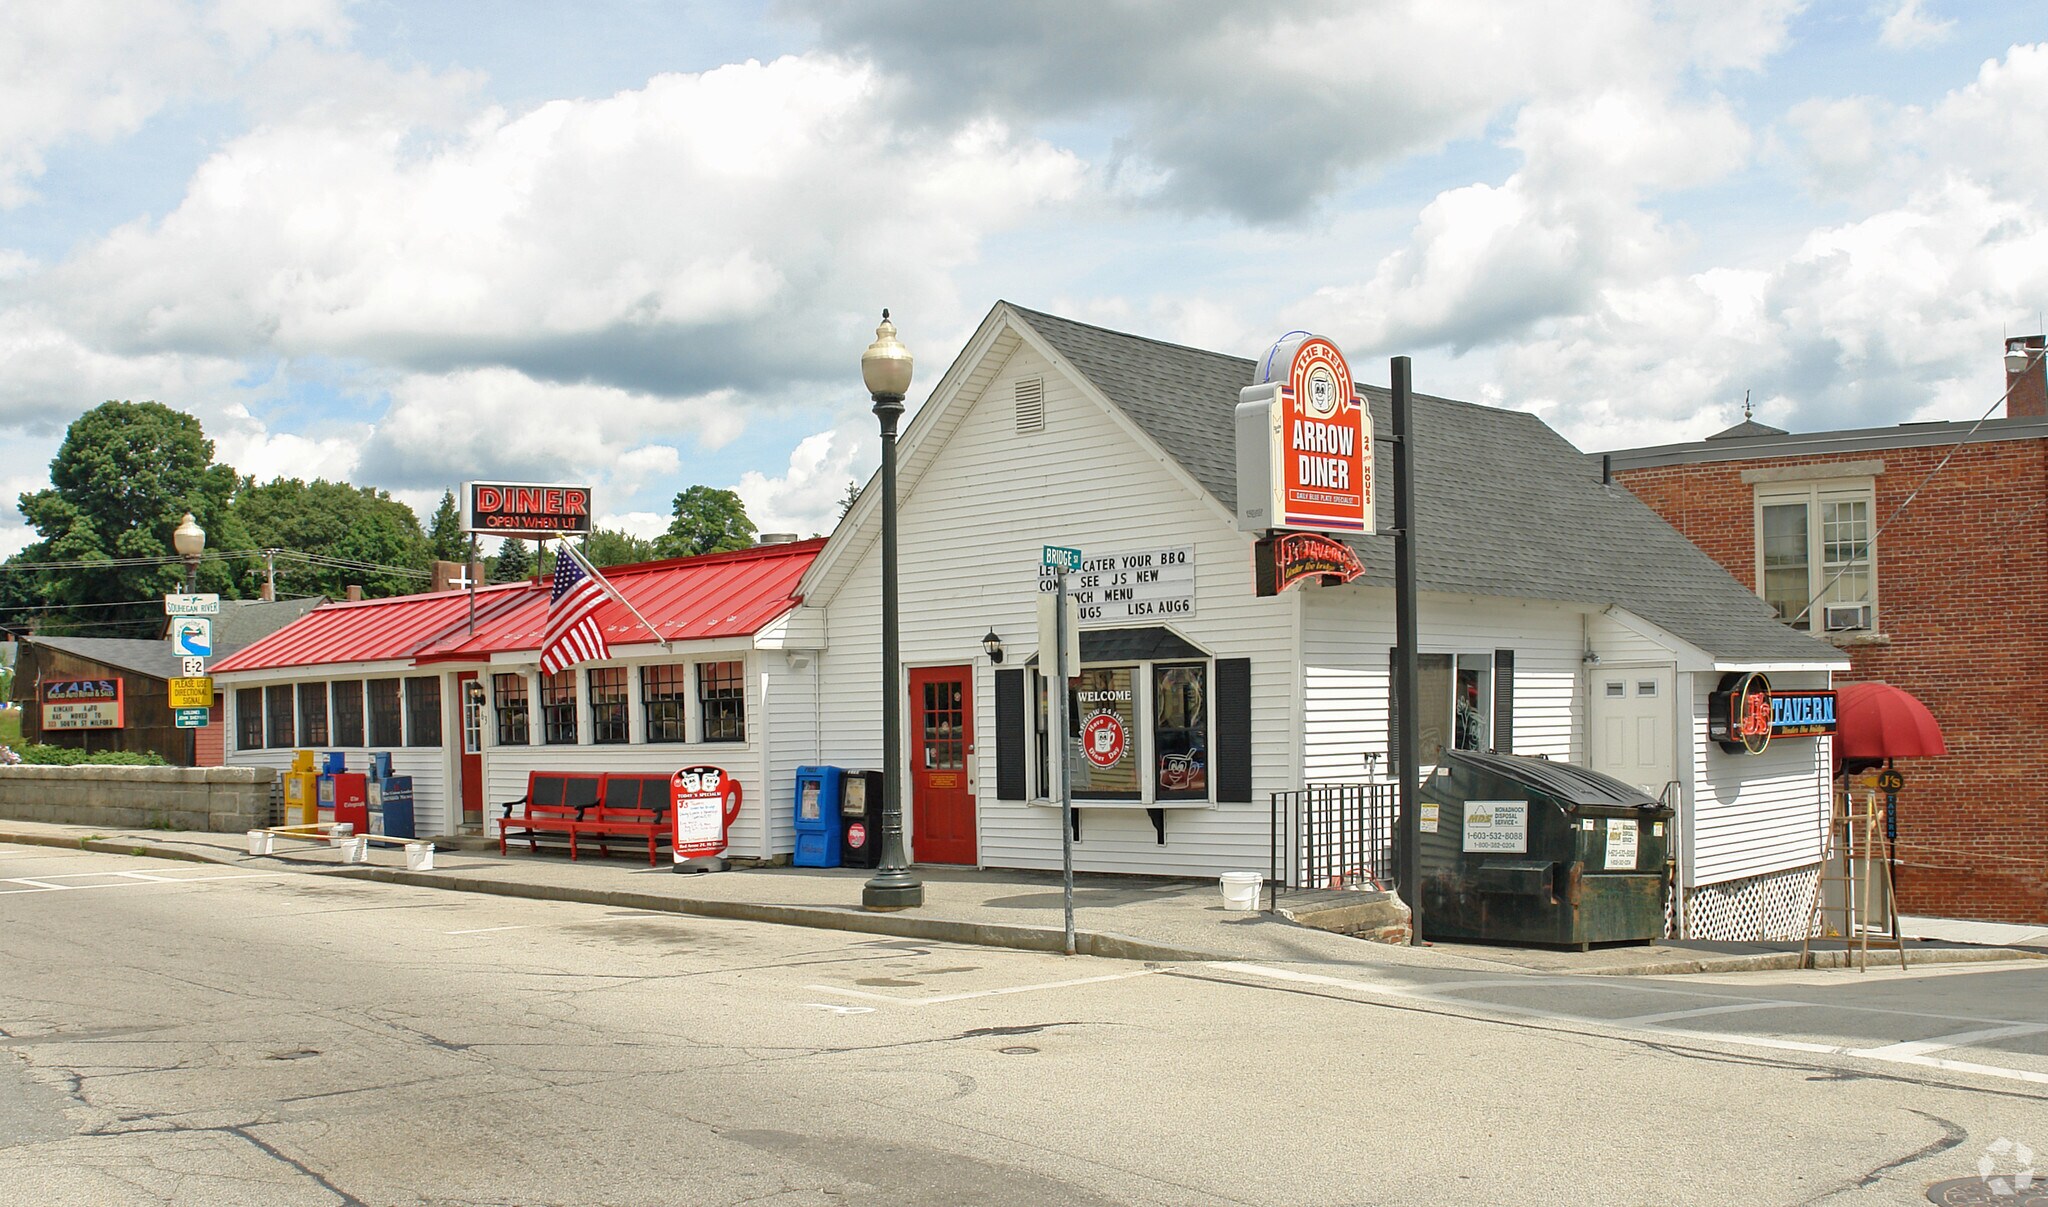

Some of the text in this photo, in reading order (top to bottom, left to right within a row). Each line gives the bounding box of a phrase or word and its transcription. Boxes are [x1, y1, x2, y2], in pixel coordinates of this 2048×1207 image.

[1296, 345, 1345, 379] THE RED
[1292, 419, 1354, 456] ARROW
[1363, 435, 1370, 451] 24
[1299, 454, 1349, 490] DINER
[477, 486, 587, 515] DINER
[486, 515, 519, 527] OPEN
[522, 516, 558, 529] WHEN
[1046, 548, 1072, 566] BRIDGE
[1082, 559, 1115, 572] CATER
[1122, 555, 1152, 568] YOUR
[1161, 551, 1186, 565] BBQ
[1081, 575, 1099, 588] SEE
[1136, 569, 1159, 583] NEW
[1104, 588, 1133, 601] MENU
[167, 601, 217, 613] SOUHEGAN RIVER
[1078, 599, 1190, 619] UG5 LISA AUG6
[184, 661, 202, 673] E-2
[174, 680, 207, 688] PLEASE USE
[174, 689, 208, 697] DIRECTIONAL
[1078, 690, 1131, 702] WELCOME
[1102, 707, 1112, 715] 24
[1771, 697, 1835, 725] TAVERN
[1078, 708, 1100, 736] ARROW
[1088, 719, 1117, 732] Have A
[1078, 738, 1086, 759] RED
[1122, 727, 1130, 759] DINER
[1089, 746, 1120, 761] Diner Day
[1880, 775, 1901, 788] J's
[1467, 814, 1493, 823] MDS
[1887, 795, 1895, 838] TAVERN
